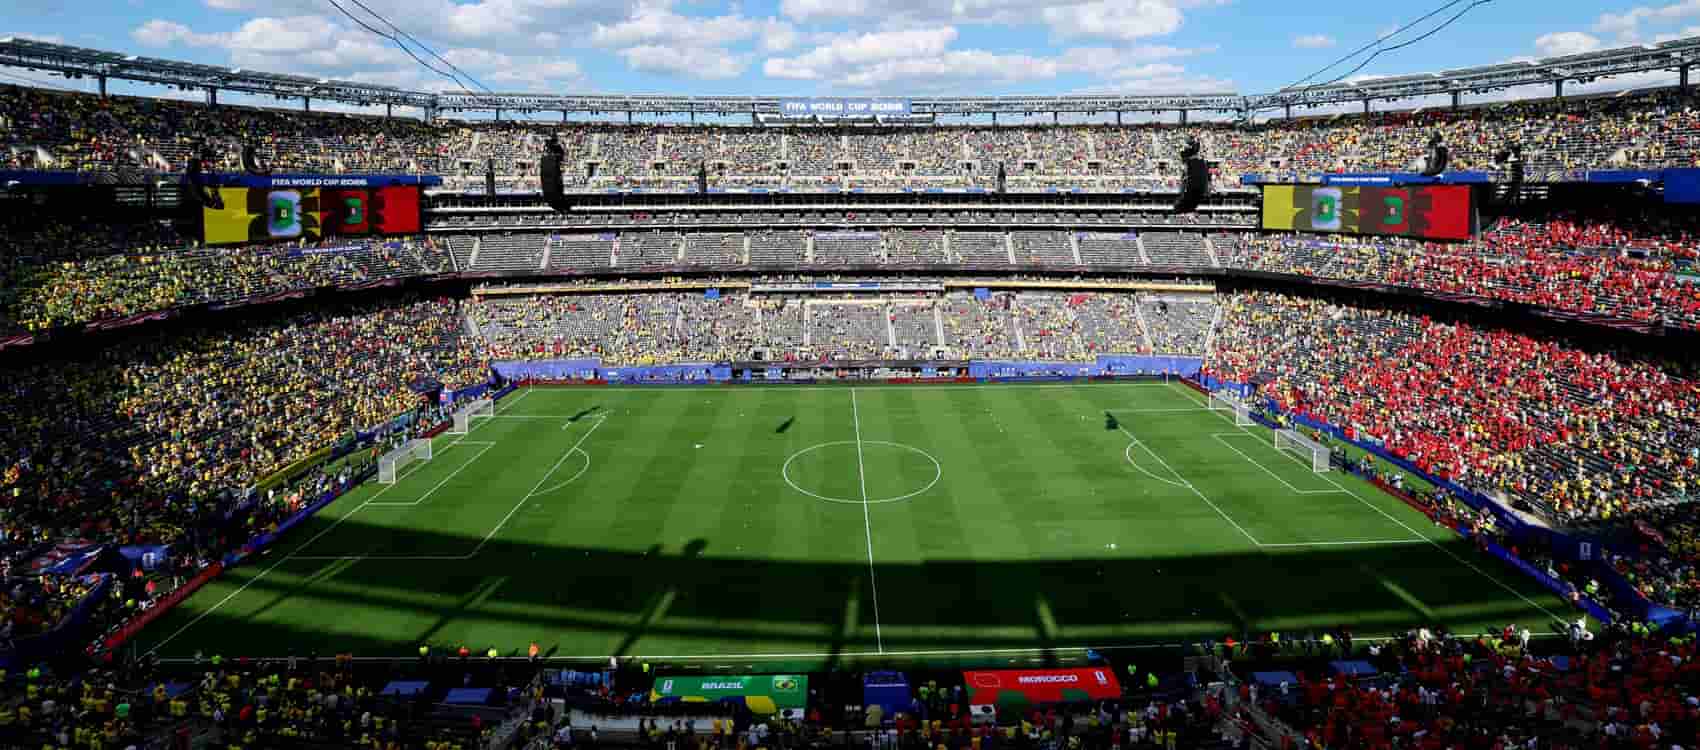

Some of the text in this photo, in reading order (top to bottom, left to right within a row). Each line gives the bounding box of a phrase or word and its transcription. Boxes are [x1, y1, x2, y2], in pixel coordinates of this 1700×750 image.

[848, 102, 868, 112] CUP
[271, 178, 291, 186] FIFA
[292, 178, 321, 186] WORLD
[323, 178, 339, 186] CUP
[1018, 675, 1078, 683] MOROCCO
[702, 681, 744, 689] BRAZIL
